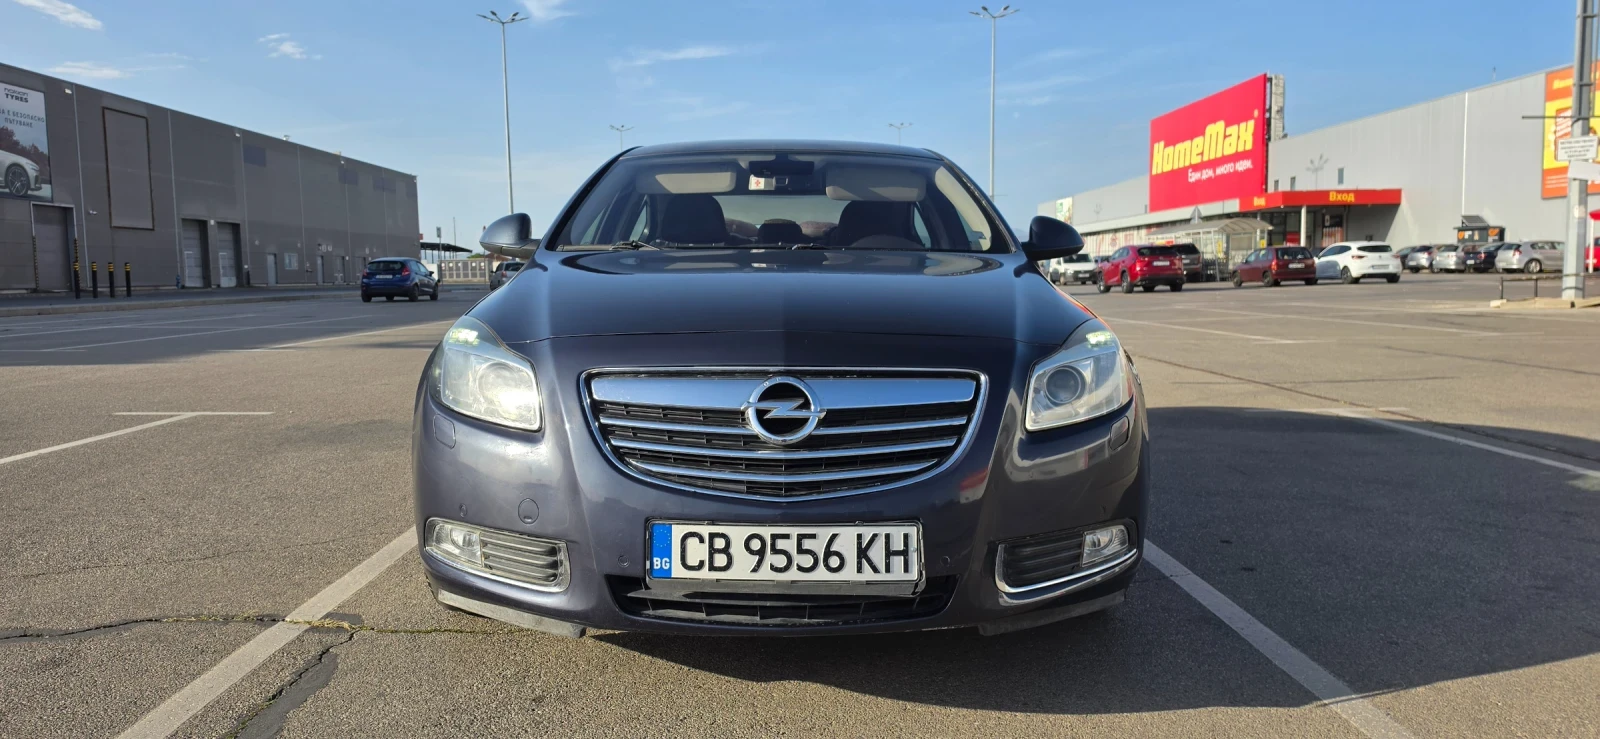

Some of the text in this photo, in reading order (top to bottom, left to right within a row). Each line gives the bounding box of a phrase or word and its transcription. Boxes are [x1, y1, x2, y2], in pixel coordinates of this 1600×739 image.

[5, 93, 28, 103] TYRES
[5, 117, 33, 128] ПЪТУВАНЕ
[12, 111, 45, 123] БЕЗОПАСНО
[1152, 119, 1255, 175] HomeMax
[1188, 159, 1253, 183] Един дом, много идеи.
[1253, 196, 1266, 206] Вход
[1329, 191, 1355, 203] Вход
[680, 531, 909, 574] CB 9556 KH
[653, 557, 670, 570] BG
